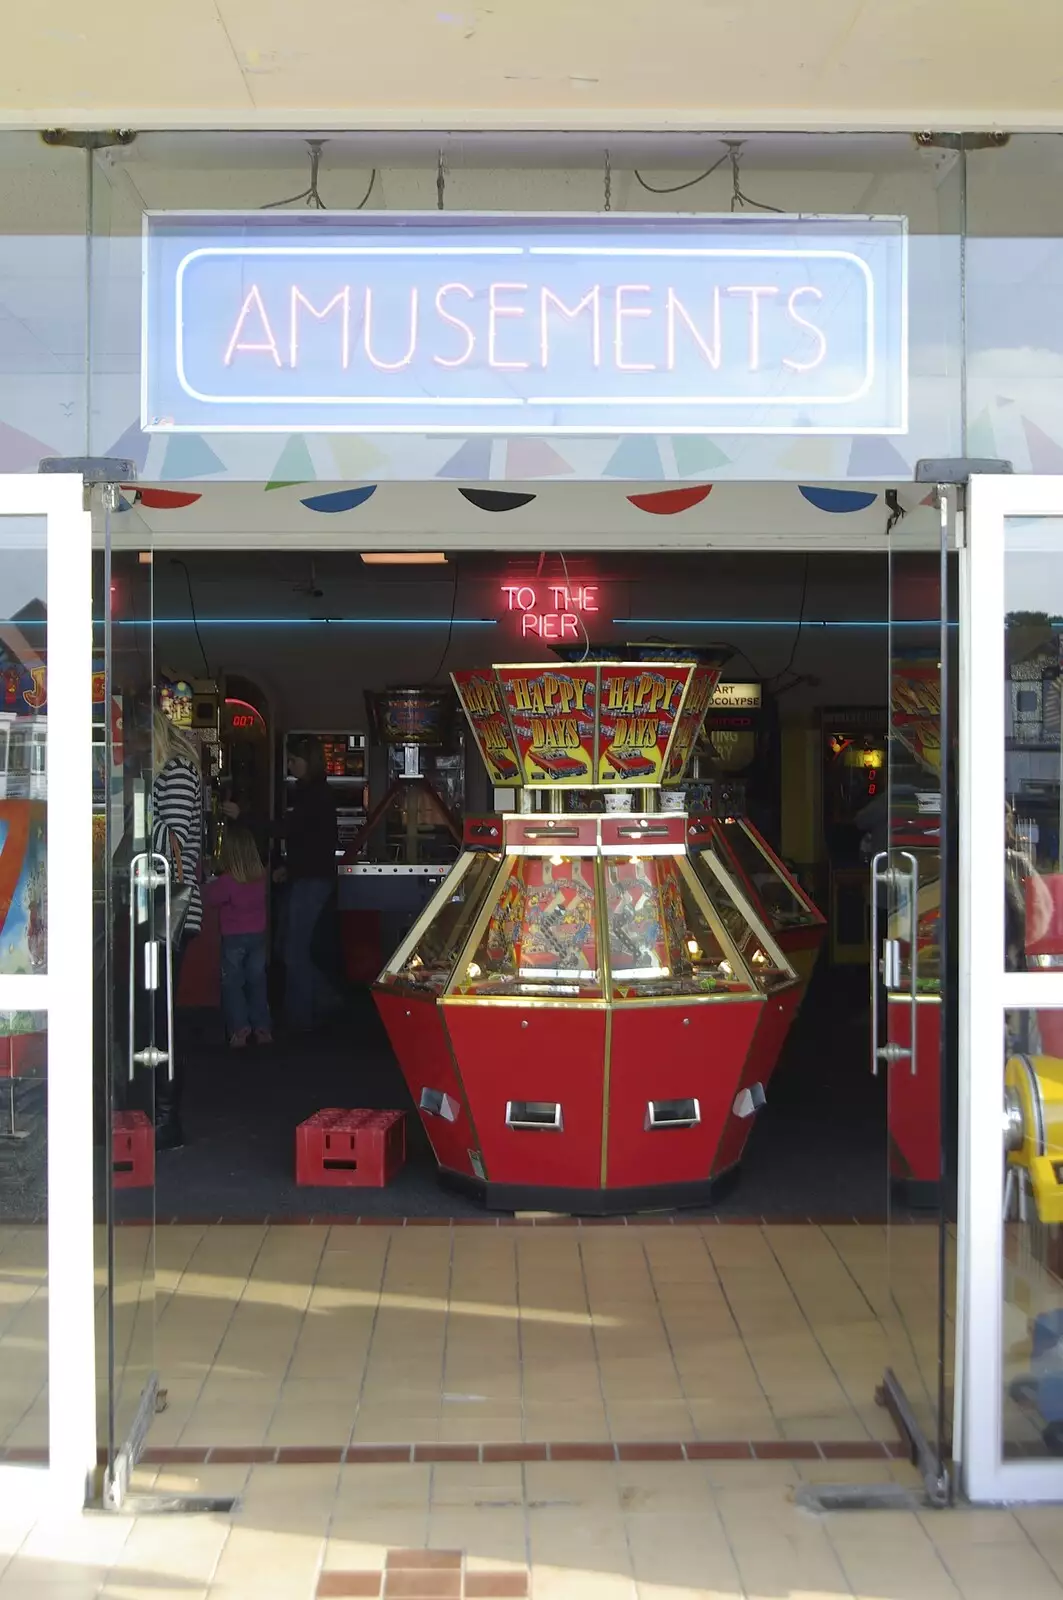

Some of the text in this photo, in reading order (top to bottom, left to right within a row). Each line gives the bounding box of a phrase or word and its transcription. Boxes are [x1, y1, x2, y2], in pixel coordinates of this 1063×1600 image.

[224, 282, 828, 373] AMUSEMENTS
[501, 586, 599, 611] TO THE
[522, 613, 579, 638] PIER
[511, 675, 587, 714] HAPPY
[607, 676, 680, 714] HAPPY
[530, 718, 581, 749] DAYS
[612, 718, 659, 748] DAYS
